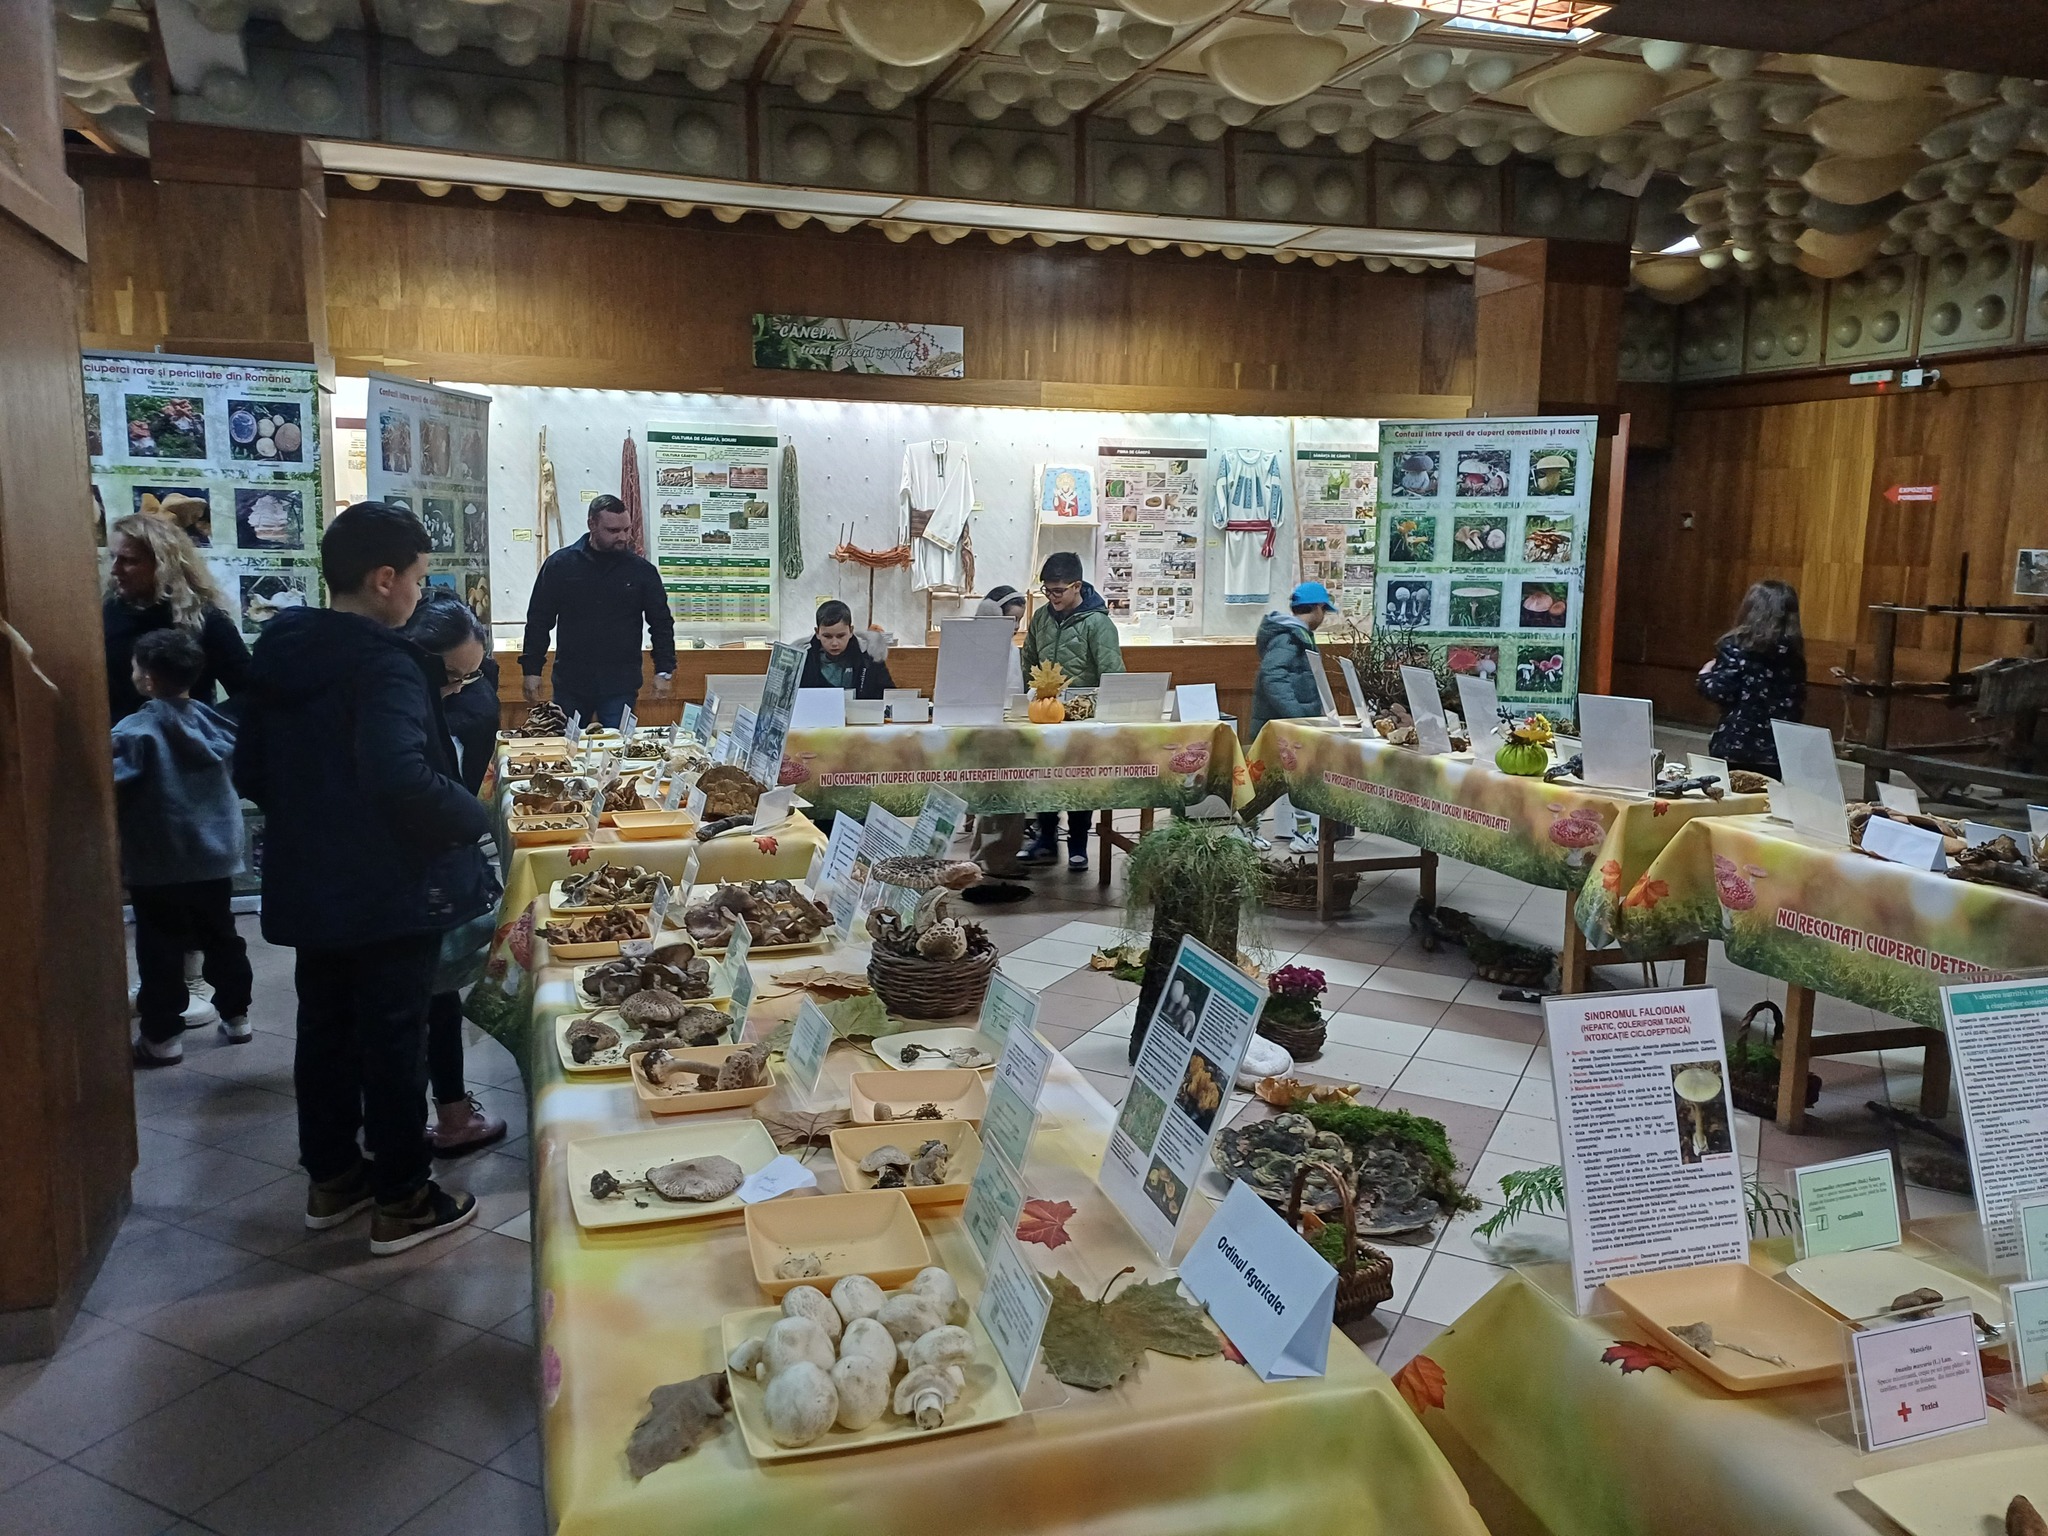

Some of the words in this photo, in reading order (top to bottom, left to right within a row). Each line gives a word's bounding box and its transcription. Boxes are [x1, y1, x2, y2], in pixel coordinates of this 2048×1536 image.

[835, 346, 874, 359] prezent
[889, 347, 917, 359] viitor
[84, 363, 130, 375] ciuperci
[132, 367, 155, 376] rare
[169, 369, 223, 381] periclitate
[226, 370, 242, 381] din
[245, 372, 291, 384] România
[1394, 430, 1424, 438] Confuzii
[1444, 430, 1464, 438] specii
[1477, 428, 1504, 437] ciuperci
[1507, 428, 1548, 436] comestibile
[820, 774, 832, 786] NU
[834, 773, 879, 787] CONSUMAȚI
[881, 772, 915, 784] CIUPERCI
[917, 771, 941, 783] CRUDE
[943, 770, 958, 782] SAU
[1064, 767, 1097, 778] CIUPERCI
[1098, 766, 1113, 777] POT
[1114, 766, 1122, 777] FI
[1324, 772, 1331, 782] NU
[1357, 781, 1378, 795] CIUPERCI
[1378, 786, 1386, 797] DE
[1386, 788, 1394, 799] LA
[1393, 790, 1420, 807] PERSOANE
[1420, 797, 1431, 810] SAU
[1431, 800, 1441, 813] DIN
[1441, 803, 1462, 819] LOCURI
[1777, 909, 1796, 929] NU
[1798, 914, 1863, 952] RECOLTAȚI
[1866, 934, 1927, 967] CIUPERCI
[1584, 1008, 1638, 1021] SINDROMUL
[1639, 1005, 1686, 1017] FALOIDIAN
[1581, 1022, 1617, 1033] (HEPATIC,
[1617, 1018, 1664, 1029] COLERIFORM
[1665, 1016, 1692, 1025] TARDIV,
[1584, 1031, 1629, 1042] INTOXICAȚIE
[1630, 1026, 1691, 1038] CICLOPEPTIDICĂ)
[1217, 1235, 1249, 1273] Ordinul
[1243, 1267, 1286, 1316] Agaricales
